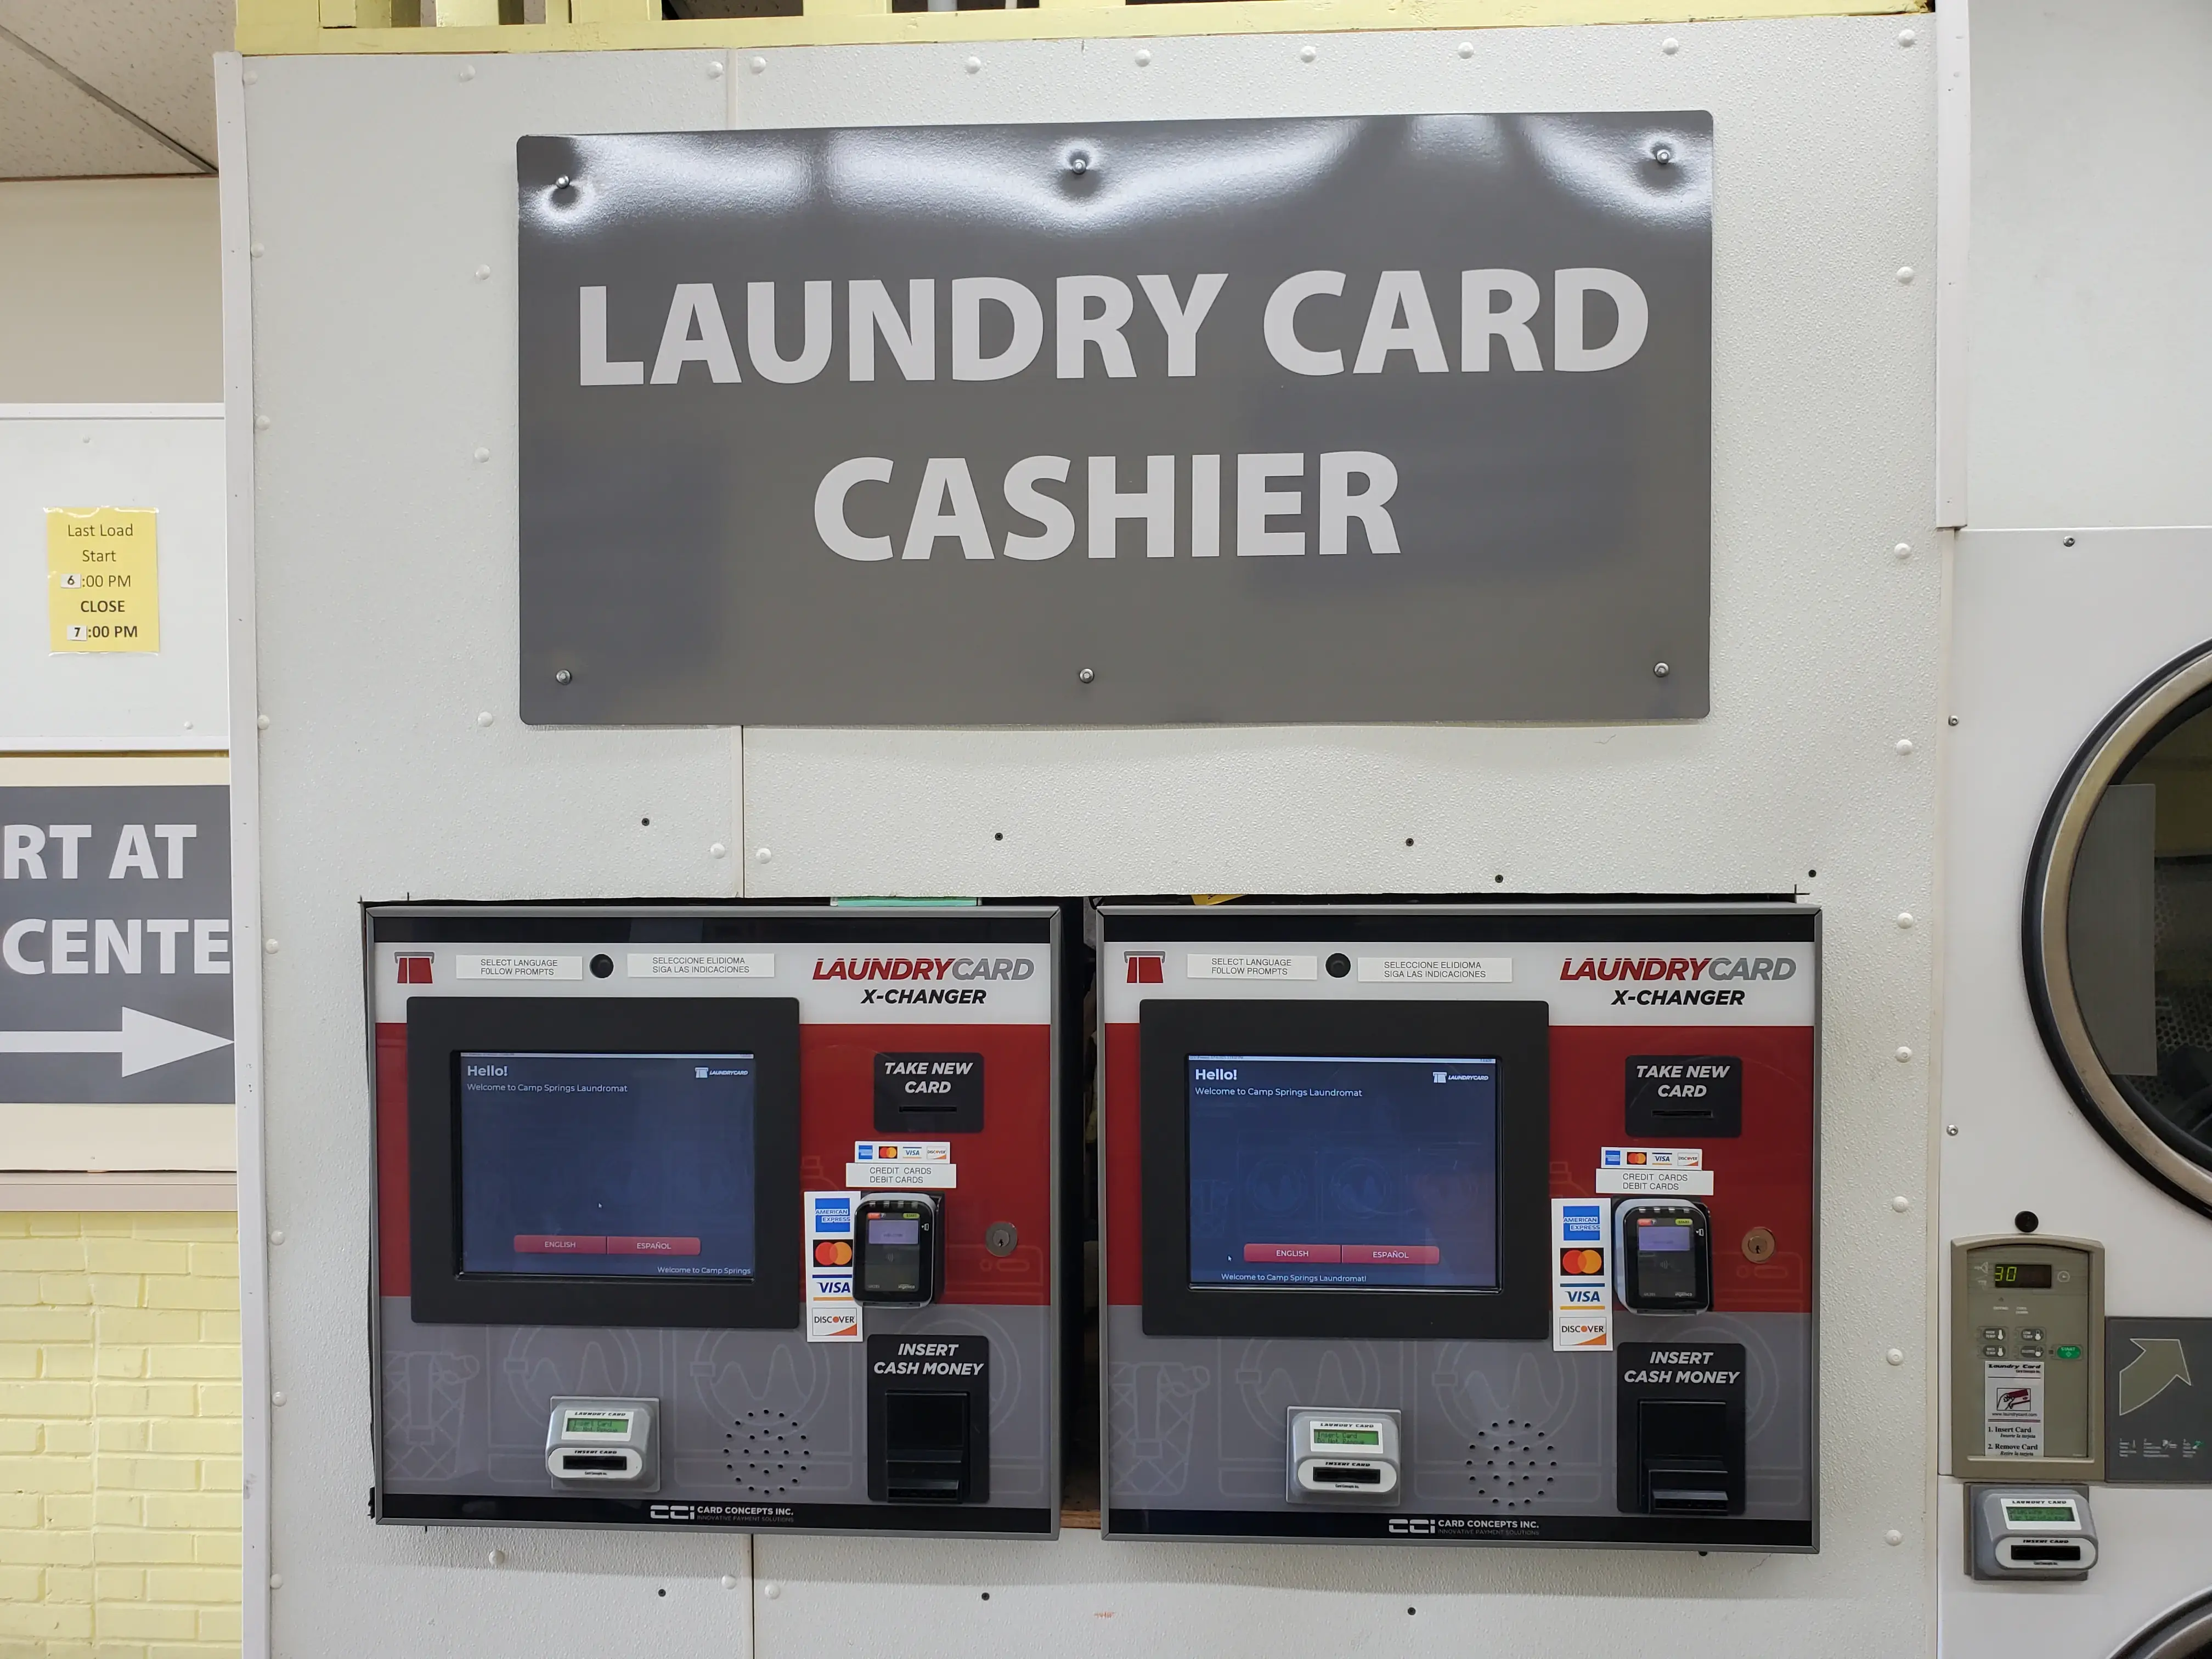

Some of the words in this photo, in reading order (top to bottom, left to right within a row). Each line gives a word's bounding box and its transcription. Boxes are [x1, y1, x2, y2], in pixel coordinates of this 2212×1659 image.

[580, 274, 1228, 385] LAUNDRY
[1264, 268, 1648, 375] CARD
[815, 452, 1400, 561] CASHIER
[68, 524, 95, 537] Last
[100, 524, 133, 537] Load
[82, 550, 116, 562] Start
[109, 575, 131, 587] PM
[81, 601, 125, 613] CLOSE
[115, 625, 138, 637] PM
[109, 825, 197, 879] AT
[3, 919, 230, 974] CENTE
[812, 958, 1034, 980] LAUNDRYCARD
[1560, 957, 1796, 981] LAUNDRYCARD
[861, 989, 986, 1004] X-CHANGER
[1611, 990, 1745, 1005] X-CHANGER
[467, 1065, 507, 1076] Hello!
[885, 1062, 928, 1074] TAKE
[932, 1063, 973, 1075] NEW
[1195, 1069, 1237, 1080] Hello!
[1637, 1065, 1683, 1078] TAKE
[1686, 1066, 1730, 1078] NEW
[467, 1084, 505, 1092] Welcome
[518, 1085, 543, 1093] Camp
[544, 1084, 575, 1093] Springs
[905, 1081, 951, 1093] CARD
[1195, 1087, 1235, 1096] Welcome
[1248, 1088, 1273, 1097] Camp
[1275, 1088, 1307, 1097] Springs
[1310, 1088, 1362, 1097] Laundromat
[1658, 1085, 1707, 1097] CARD
[637, 1241, 672, 1250] ESPAÑOL
[1373, 1250, 1409, 1259] ESPAÑOL
[701, 1267, 723, 1276] Camp
[724, 1267, 751, 1276] Springs
[1995, 1266, 2017, 1282] 30
[1221, 1273, 1256, 1281] Welcome
[1267, 1274, 1289, 1282] Camp
[1290, 1273, 1318, 1283] Springs
[817, 1282, 850, 1293] VISA
[1565, 1291, 1600, 1302] VISA
[898, 1343, 959, 1356] INSERT
[1650, 1351, 1714, 1364] INSERT
[874, 1362, 919, 1374] CASH
[923, 1362, 984, 1375] MONEY
[1624, 1370, 1672, 1383] CASH
[1675, 1371, 1740, 1384] MONEY
